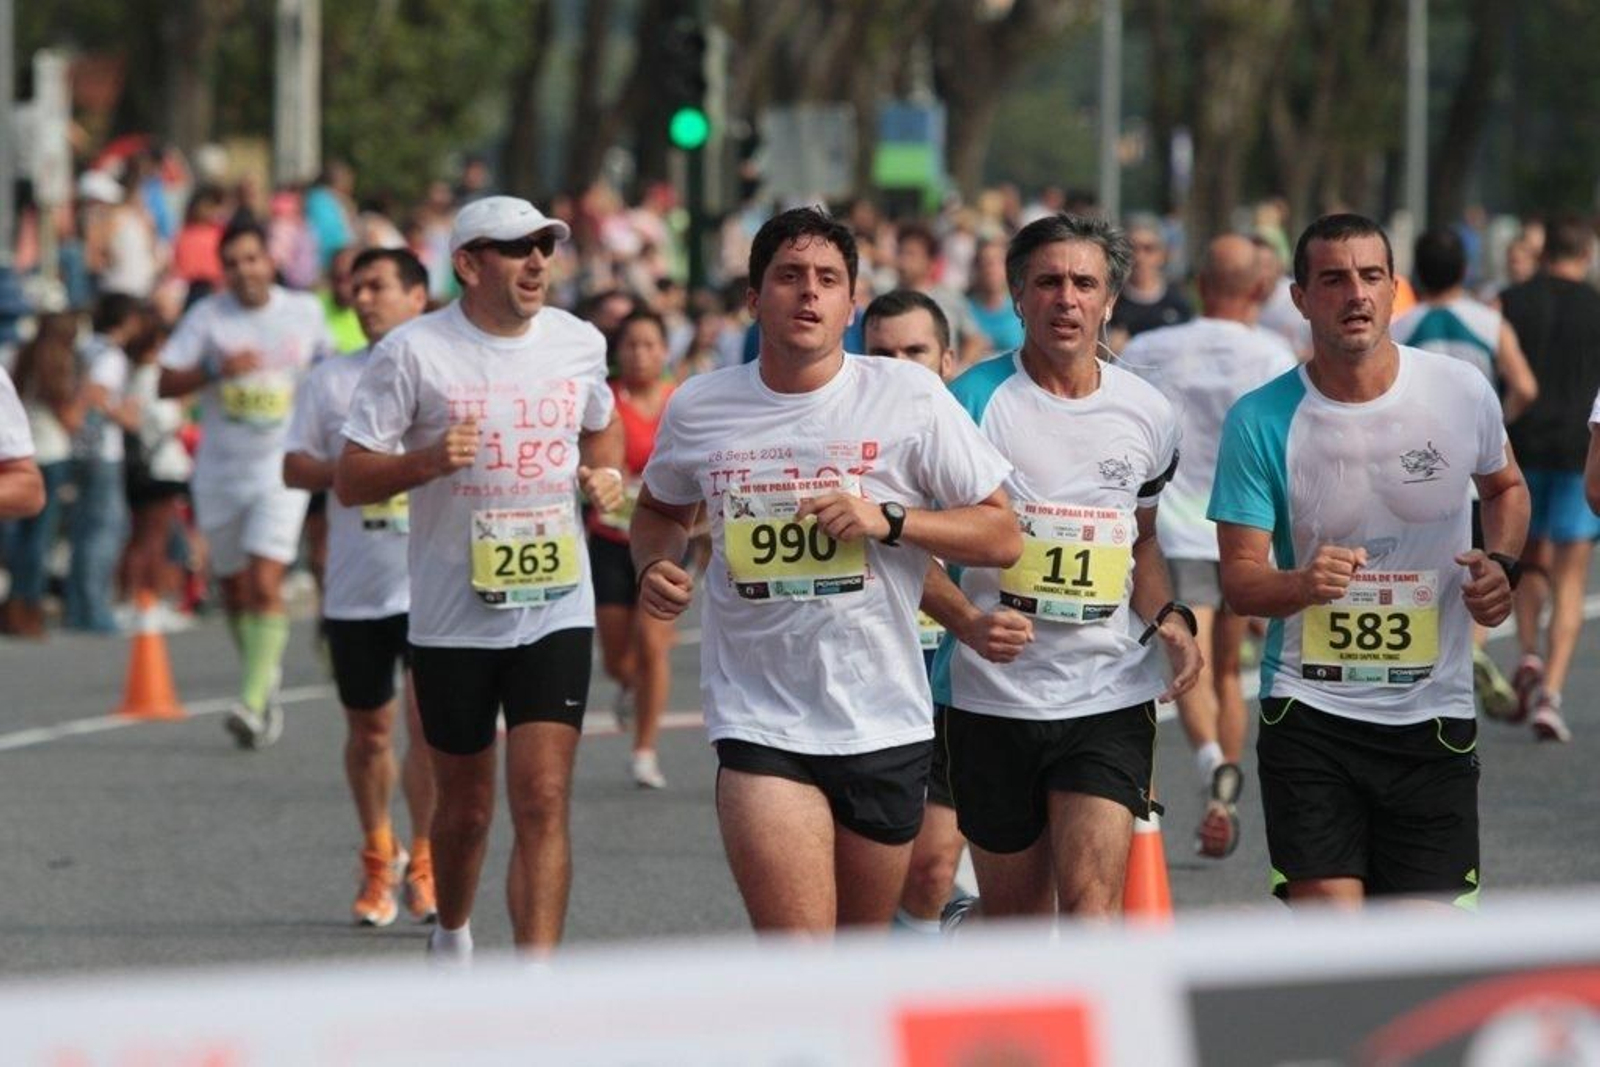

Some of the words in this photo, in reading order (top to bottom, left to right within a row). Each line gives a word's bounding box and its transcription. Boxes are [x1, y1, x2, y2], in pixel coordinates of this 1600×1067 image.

[725, 448, 756, 464] Sept
[761, 446, 793, 461] 2014
[769, 482, 796, 493] PRAIA
[494, 541, 560, 577] 263
[751, 522, 837, 565] 990
[1042, 546, 1094, 588] 11
[1379, 574, 1391, 583] DE
[1393, 574, 1419, 583] SAMIL
[1329, 611, 1412, 651] 583
